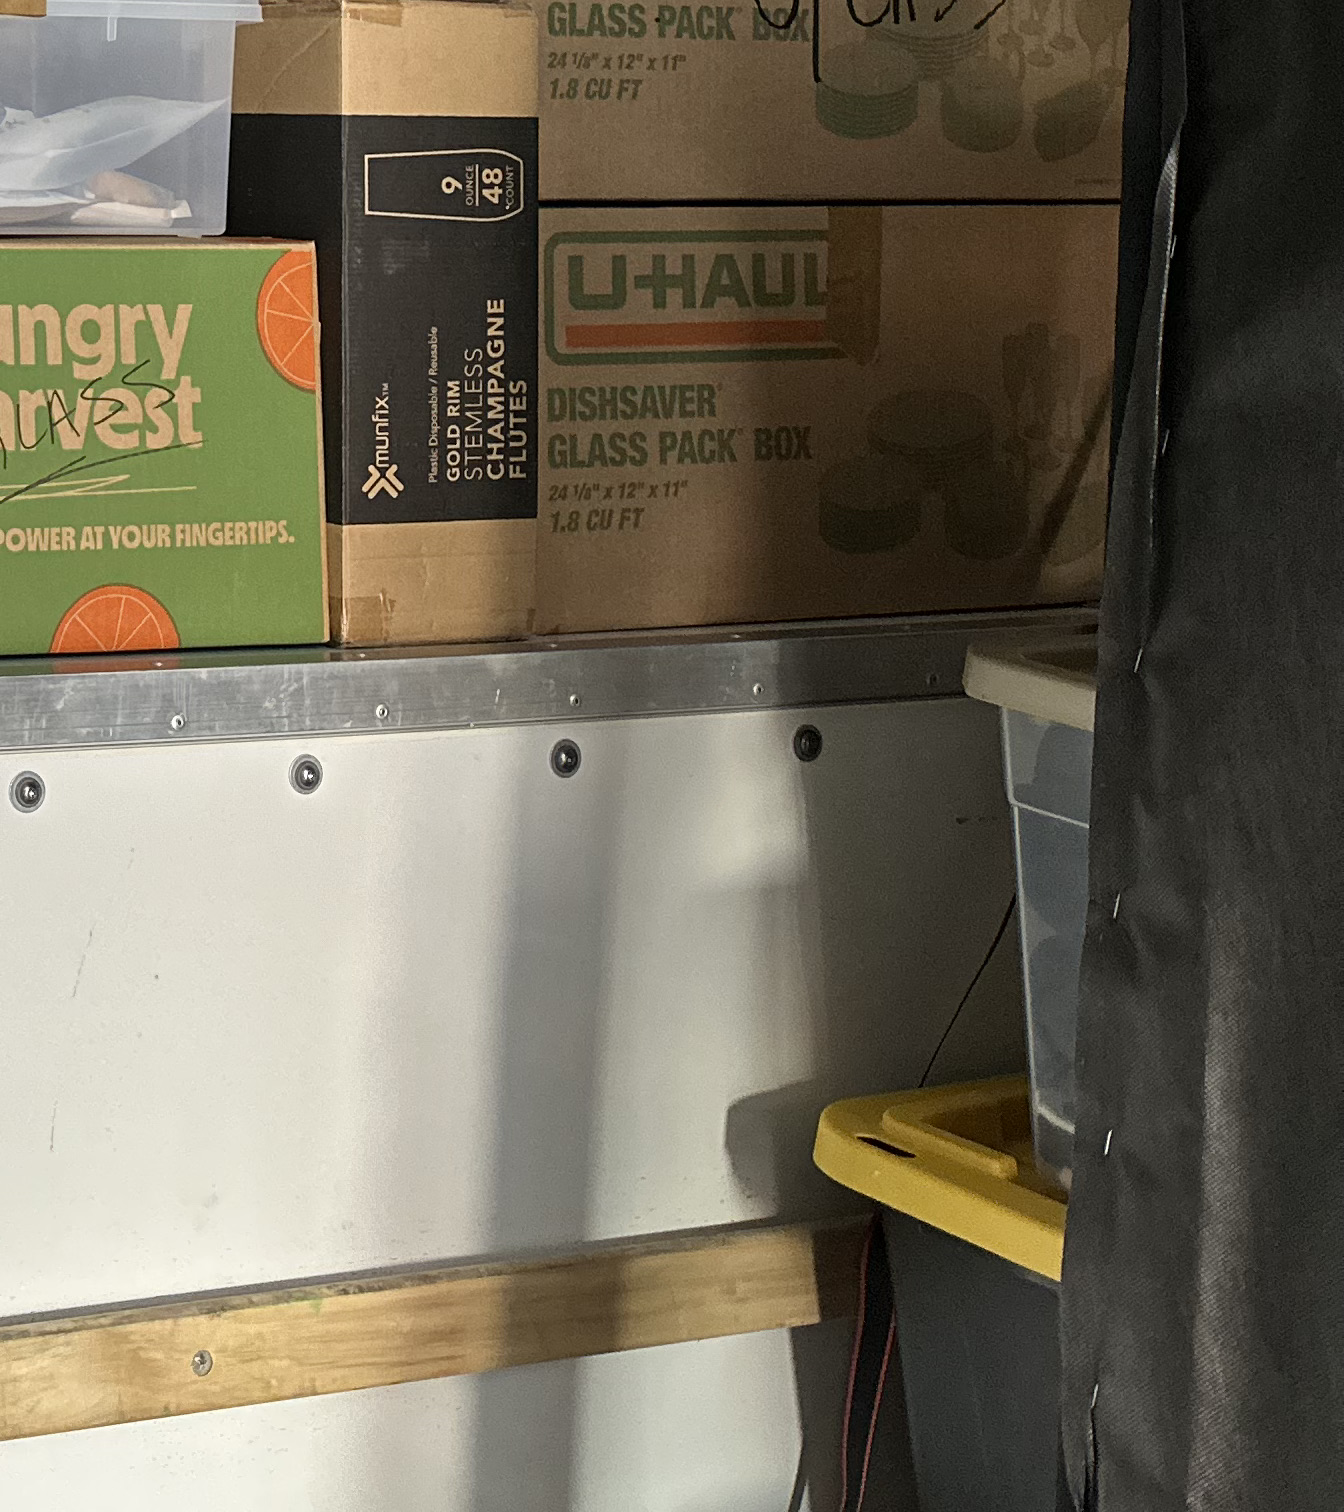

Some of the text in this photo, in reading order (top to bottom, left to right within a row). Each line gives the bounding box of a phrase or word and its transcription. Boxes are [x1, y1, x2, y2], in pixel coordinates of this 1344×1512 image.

[547, 3, 810, 42] GLASS PACK BOX
[547, 52, 569, 69] 24
[549, 78, 642, 100] 1.8 CU FT
[441, 165, 474, 206] 9 OUNCE
[482, 165, 515, 206] 48 COUNT
[567, 252, 829, 312] U-HAUL
[428, 326, 438, 375] Reusable
[486, 298, 506, 481] CHAMPAGNE
[547, 384, 718, 423] DISHSAVER
[428, 385, 440, 451] Disposable
[446, 380, 461, 482] GOLD RIM
[464, 348, 484, 481] STEMLESS
[510, 379, 528, 479] FLUTES
[428, 453, 439, 483] Plastic
[547, 425, 811, 470] GLASS PACK BOX
[548, 483, 570, 502] 24
[80, 525, 105, 551] AT
[109, 523, 172, 549] YOUR
[175, 519, 296, 548] FINGERTIPS.
[550, 508, 645, 533] 1.8 CU FT
